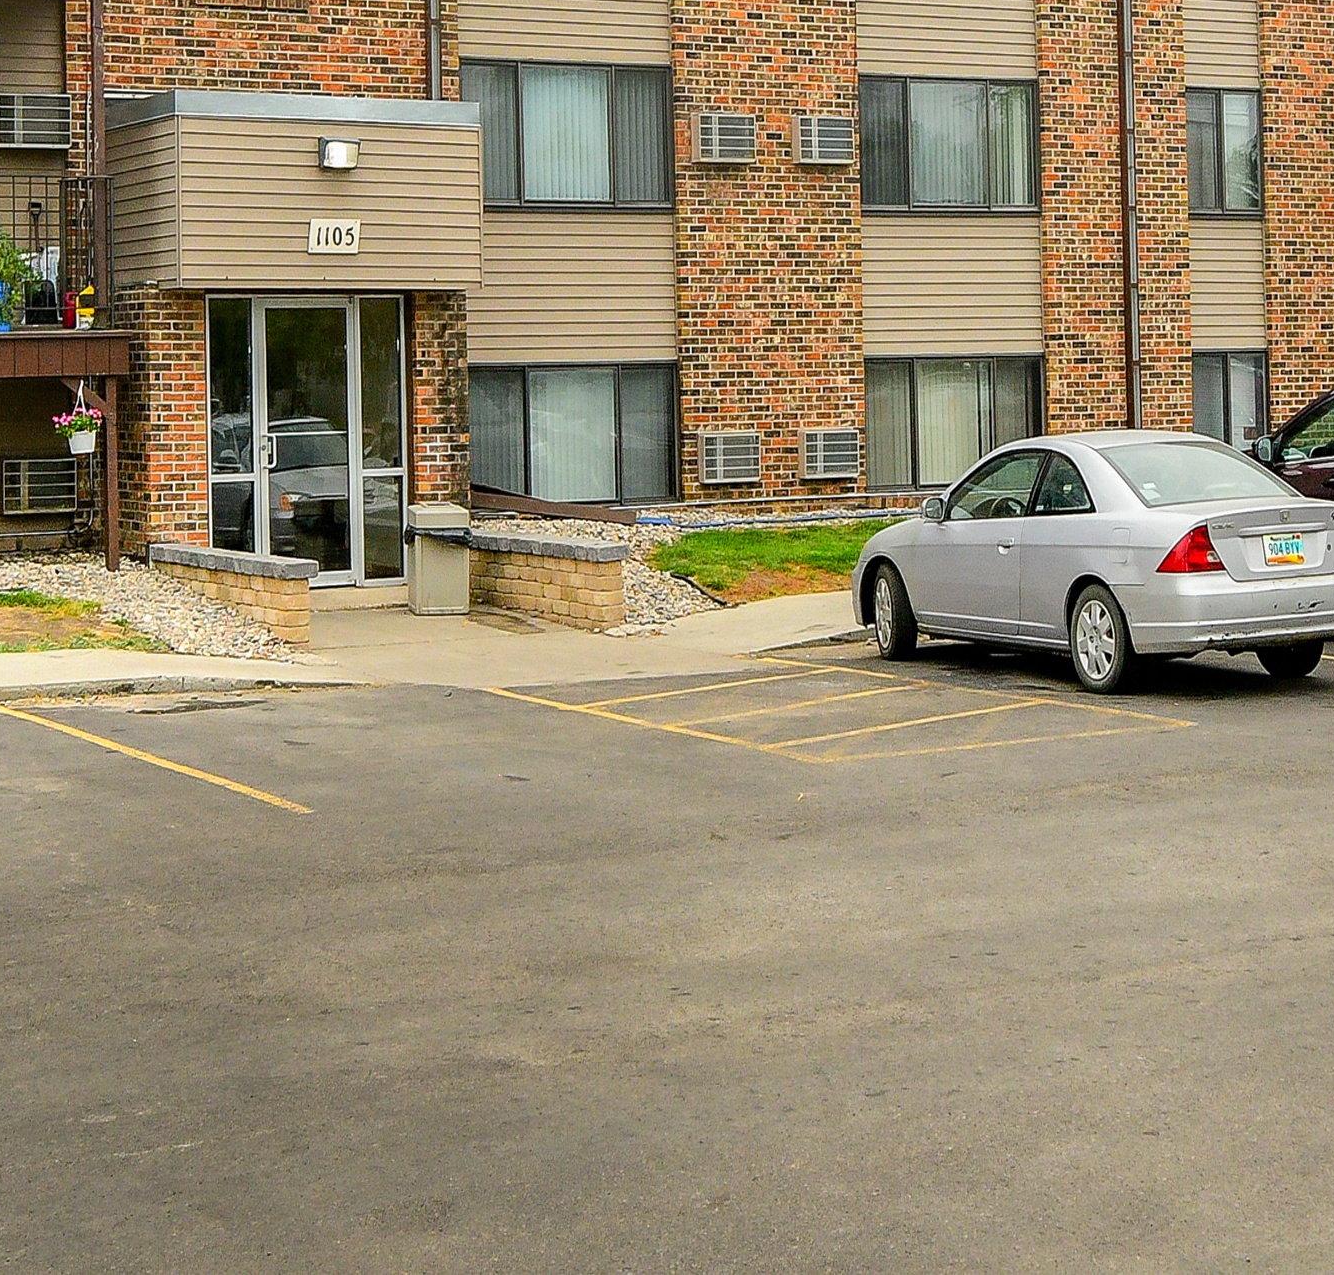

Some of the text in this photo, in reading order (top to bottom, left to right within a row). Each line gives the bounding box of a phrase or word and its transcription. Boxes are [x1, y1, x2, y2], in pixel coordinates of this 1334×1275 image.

[317, 226, 355, 246] 1105
[1268, 541, 1300, 556] 904 BYV
